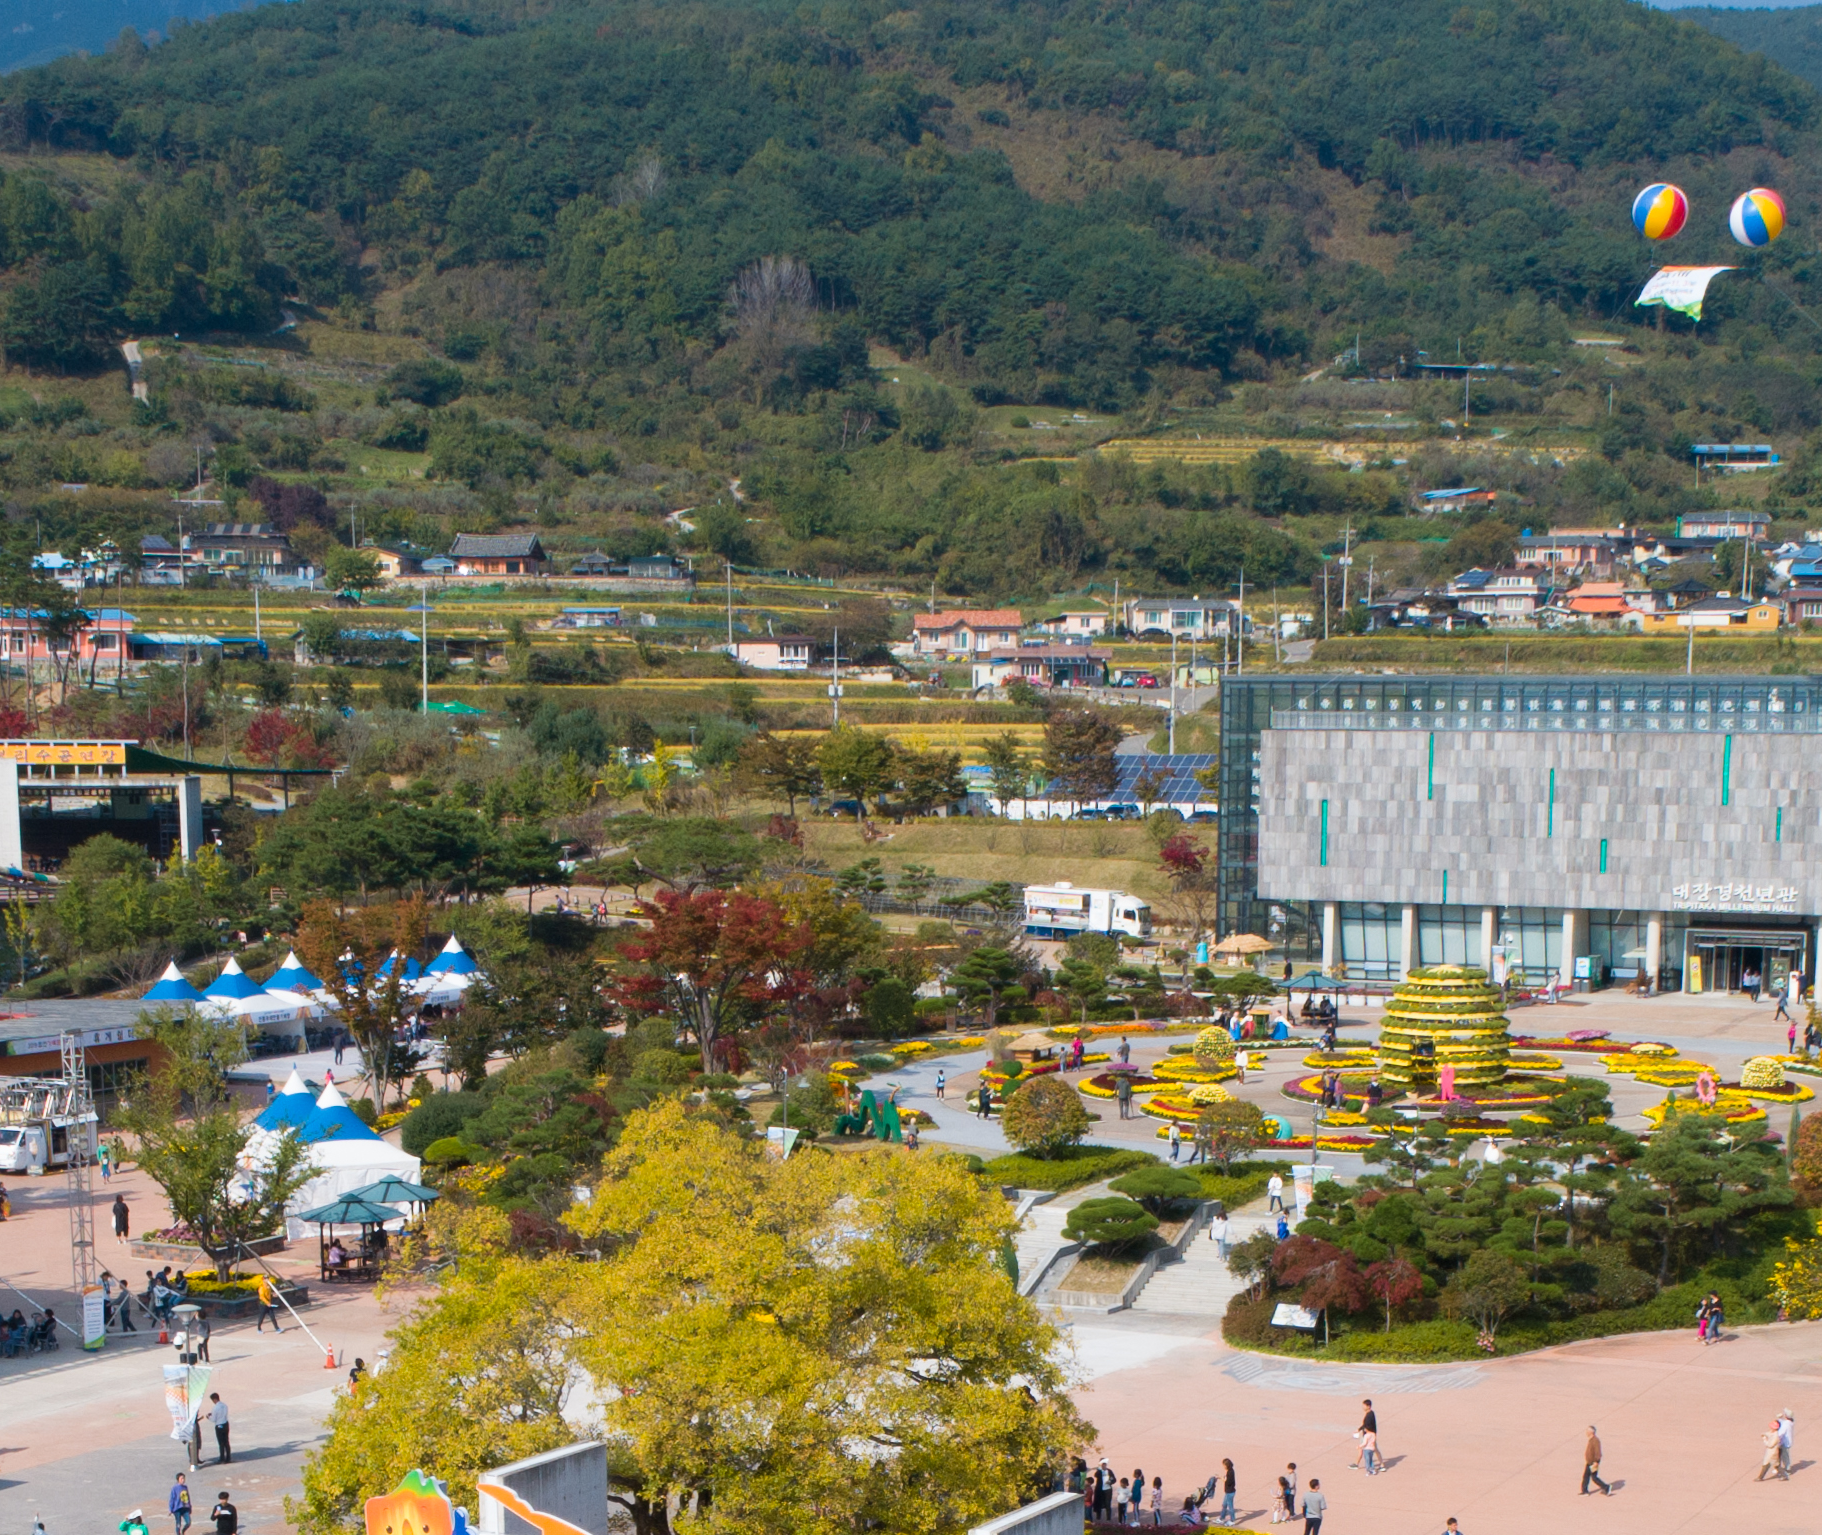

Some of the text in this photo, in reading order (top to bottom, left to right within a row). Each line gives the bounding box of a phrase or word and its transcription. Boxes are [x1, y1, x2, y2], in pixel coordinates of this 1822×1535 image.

[1672, 882, 1799, 903] 대장경천년관
[1673, 901, 1795, 913] TRIPITAKA MILLENNIUM HALL
